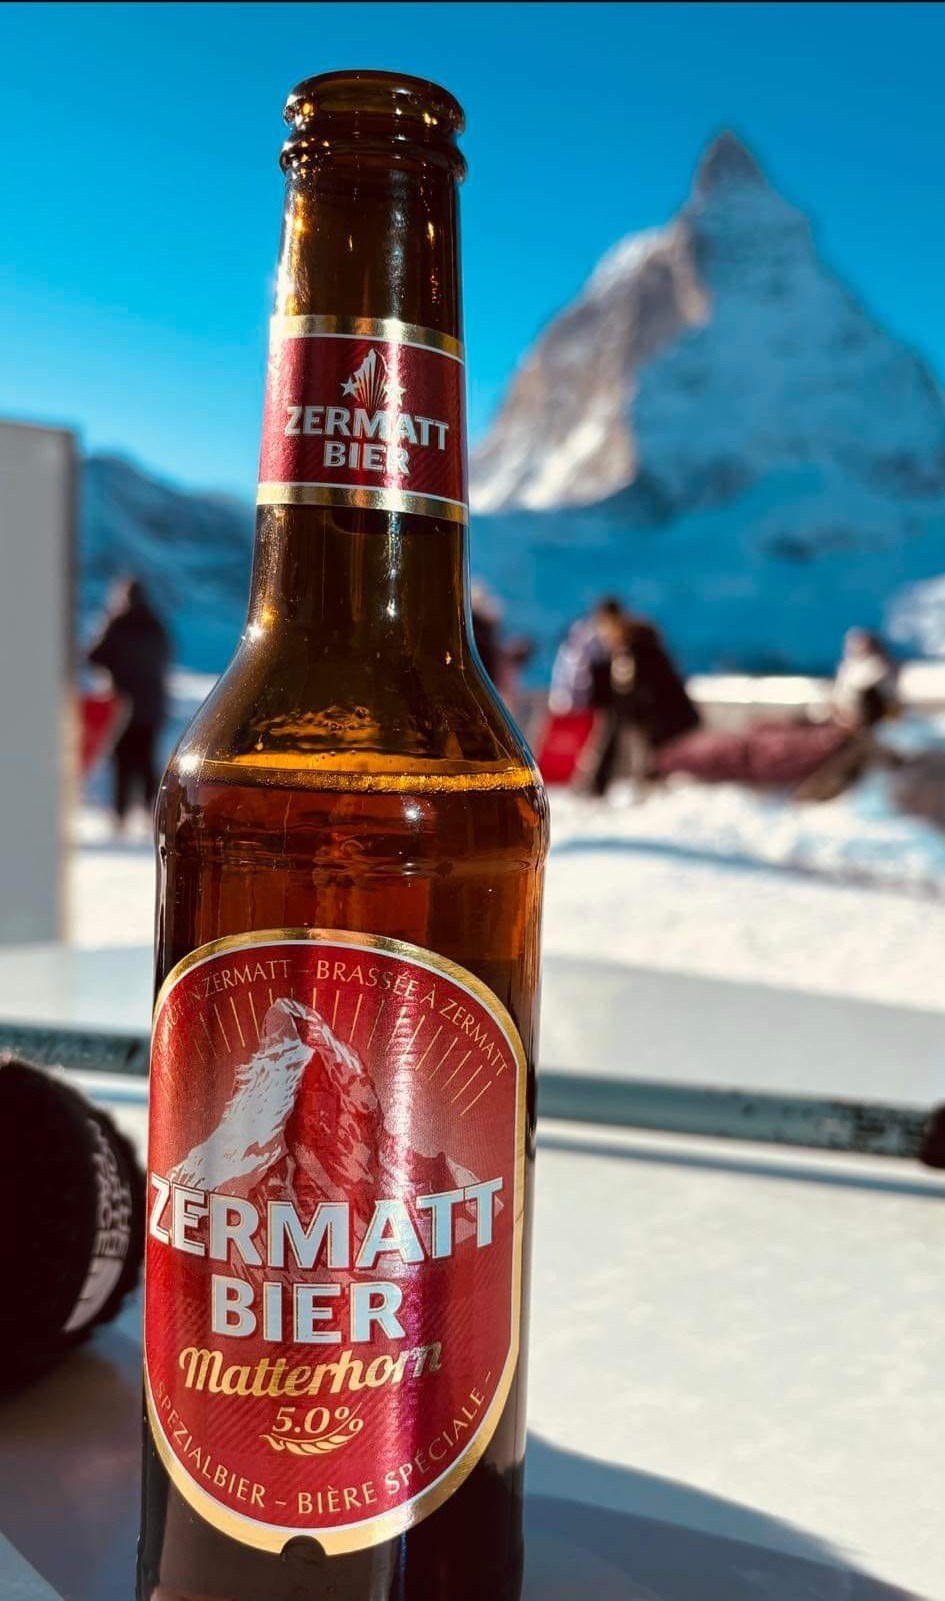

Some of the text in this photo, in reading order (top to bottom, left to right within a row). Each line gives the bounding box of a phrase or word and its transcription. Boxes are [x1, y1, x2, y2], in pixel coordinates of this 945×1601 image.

[284, 405, 449, 450] ZERMATT
[323, 441, 410, 474] BIER
[201, 960, 292, 998] ZERMATT
[316, 960, 419, 1000] BRASSÉE
[420, 984, 435, 1009] À
[439, 998, 508, 1077] ZERMATT
[149, 1172, 503, 1268] ZERMATT
[211, 1274, 406, 1343] BIER
[178, 1341, 442, 1397] Matterhorn
[157, 1382, 266, 1508] SPEZIALBIER
[298, 1481, 378, 1514] BIÈRE
[384, 1387, 485, 1496] SPÉCIALE
[272, 1403, 364, 1436] 5.0%
